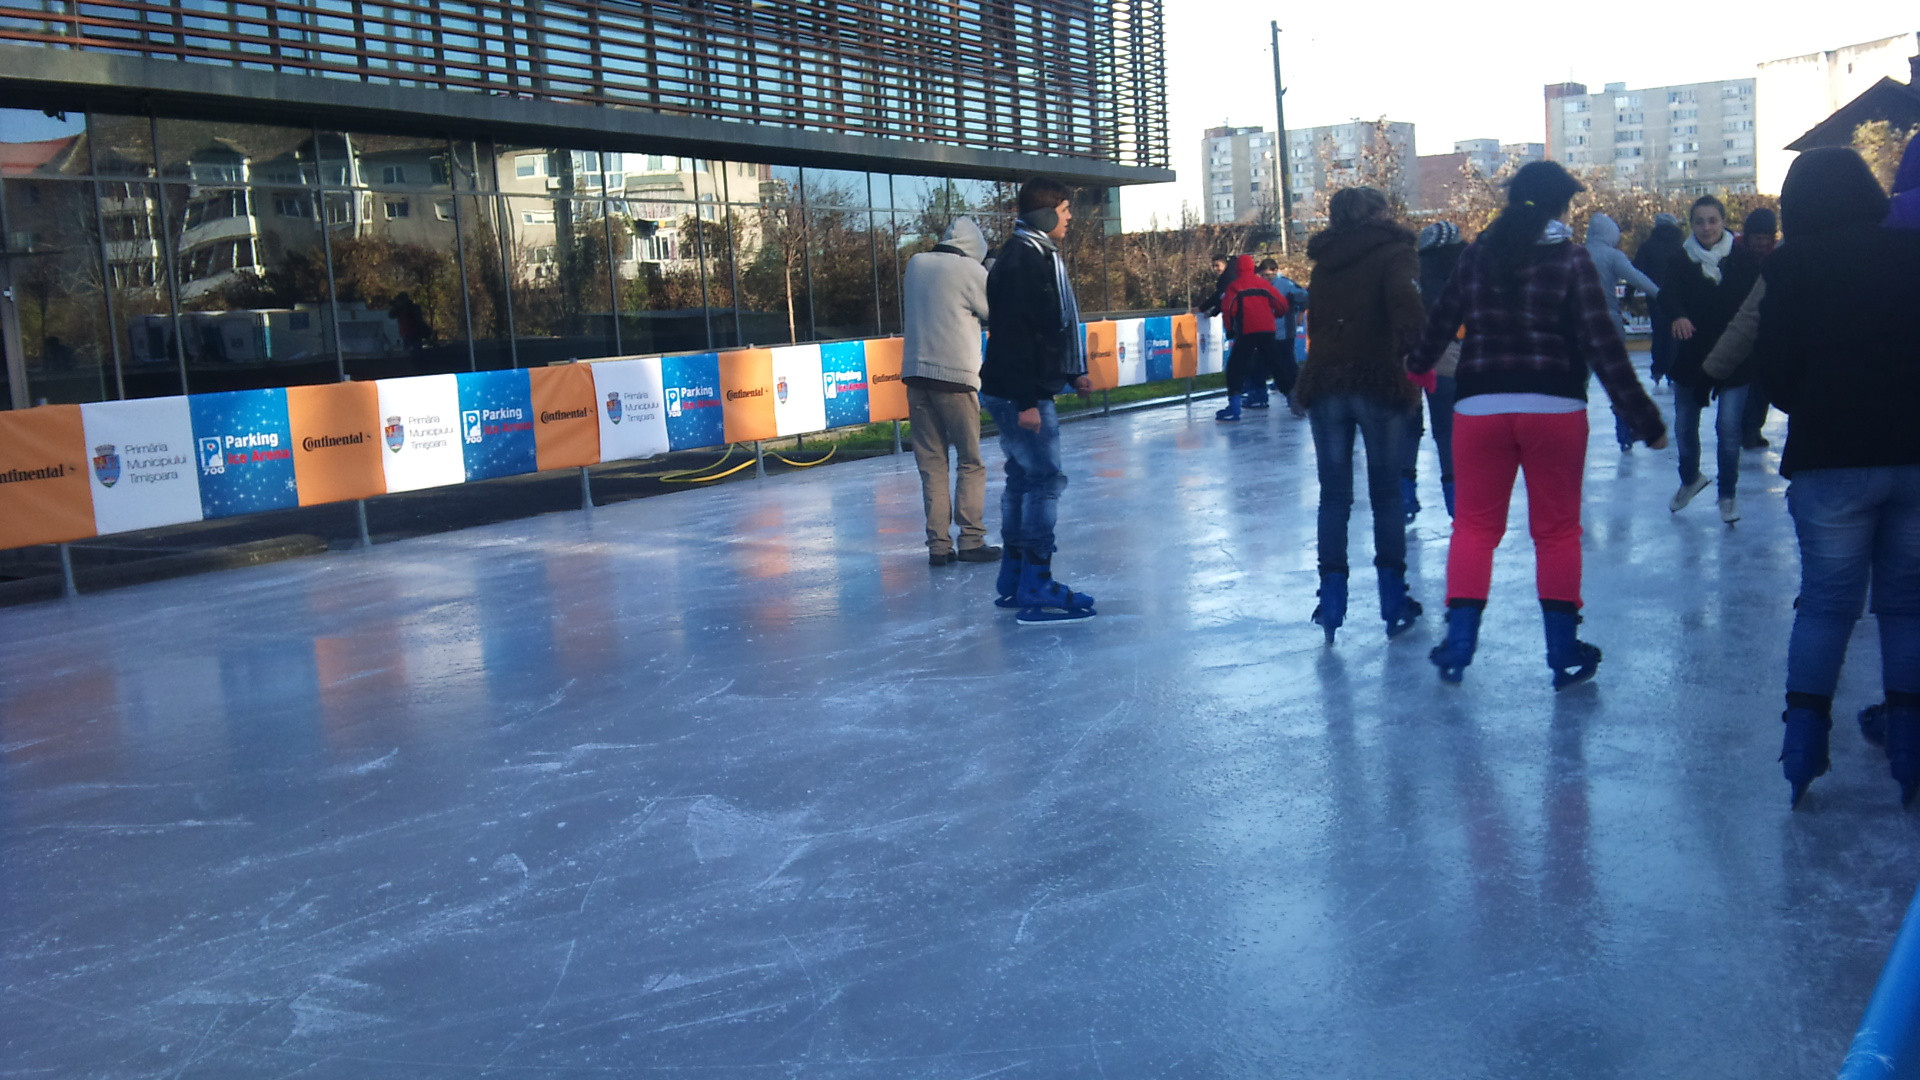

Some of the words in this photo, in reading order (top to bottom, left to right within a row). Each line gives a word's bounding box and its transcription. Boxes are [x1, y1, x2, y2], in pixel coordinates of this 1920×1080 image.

[872, 374, 902, 385] Continenta
[680, 386, 714, 398] Parking
[726, 387, 764, 402] Continental
[482, 407, 523, 421] Parking
[540, 407, 588, 424] Continental
[225, 432, 279, 449] Parking
[302, 431, 364, 452] Continental
[227, 452, 248, 465] Ice
[251, 449, 290, 462] Arena
[0, 464, 64, 484] ntinental
[203, 466, 225, 475] 700
